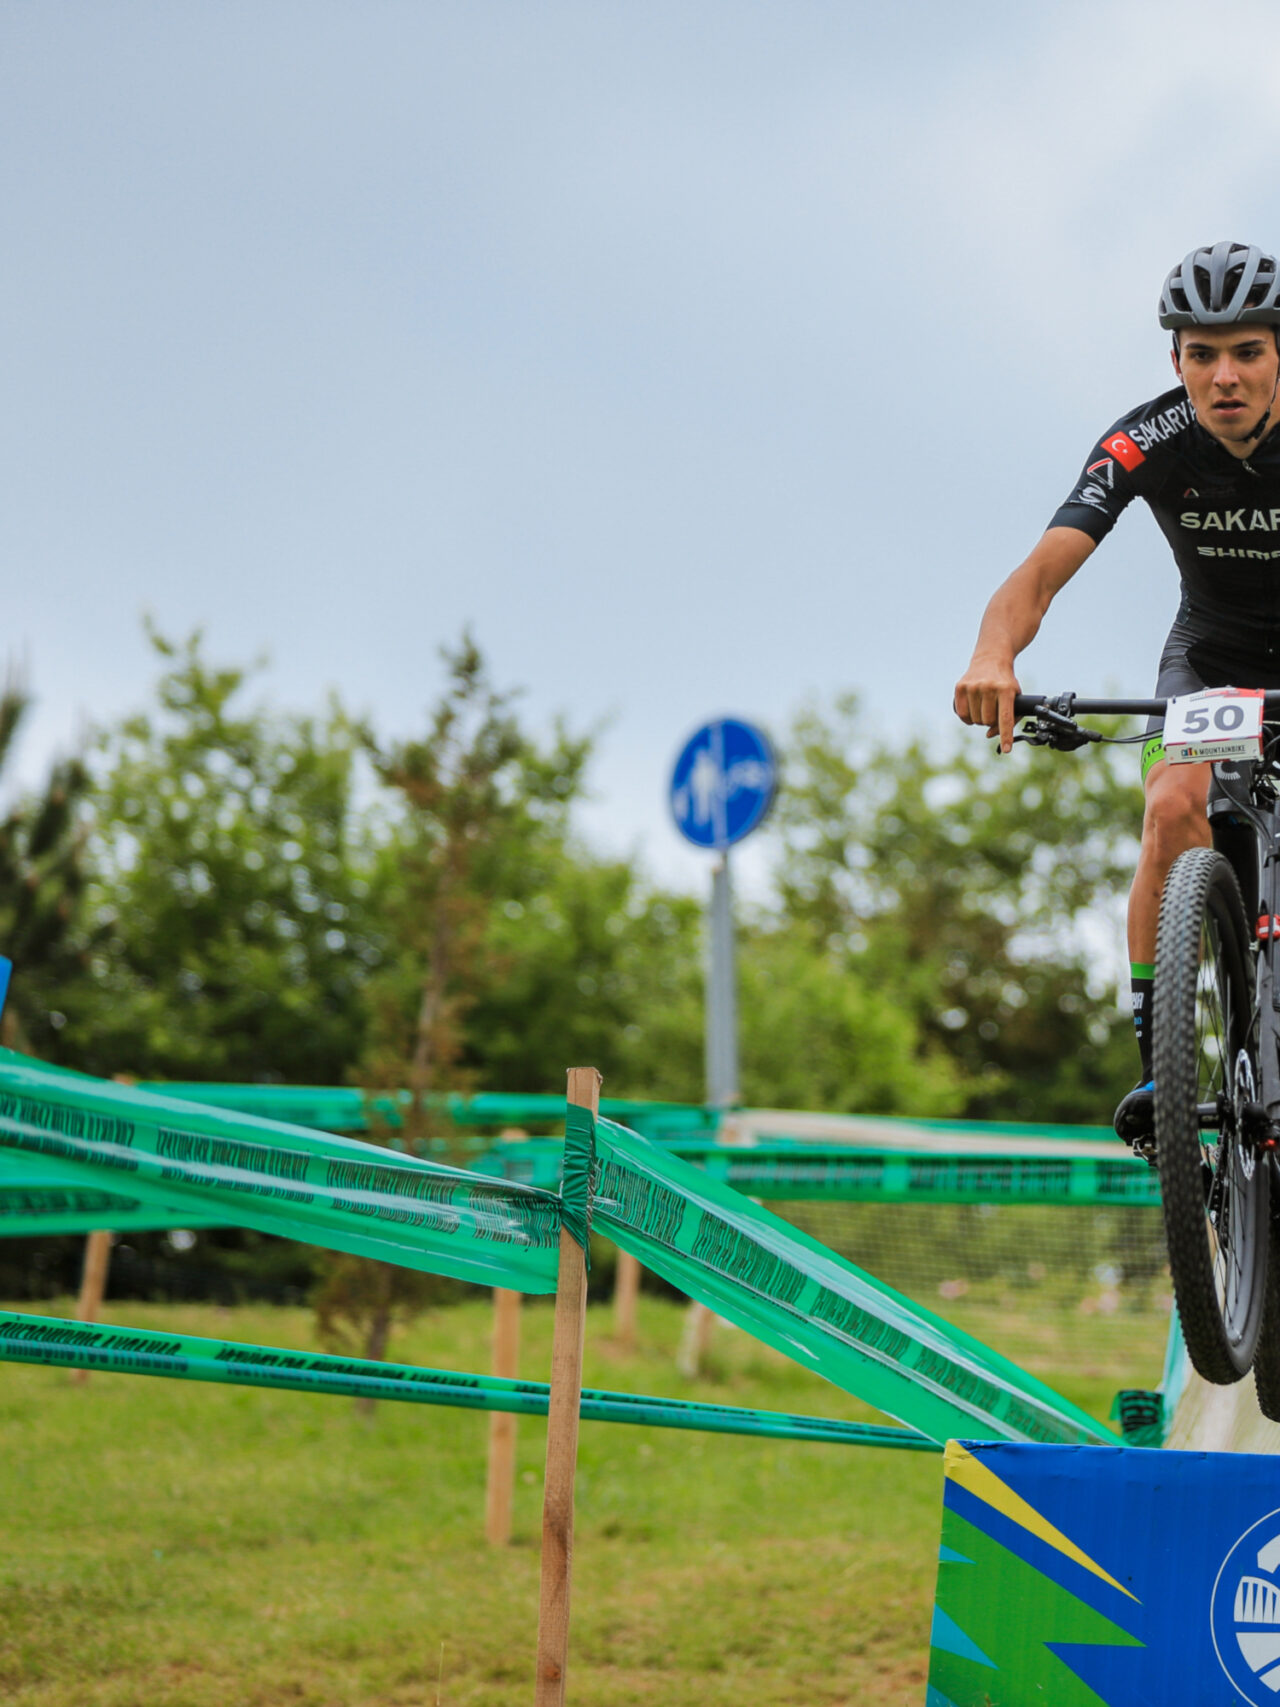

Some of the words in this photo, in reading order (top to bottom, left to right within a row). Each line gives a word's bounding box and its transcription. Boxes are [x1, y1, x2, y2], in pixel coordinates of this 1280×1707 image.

[1129, 399, 1196, 452] SAKARYA
[1182, 705, 1244, 734] 50
[1199, 744, 1246, 755] MOUNTAINBIKE
